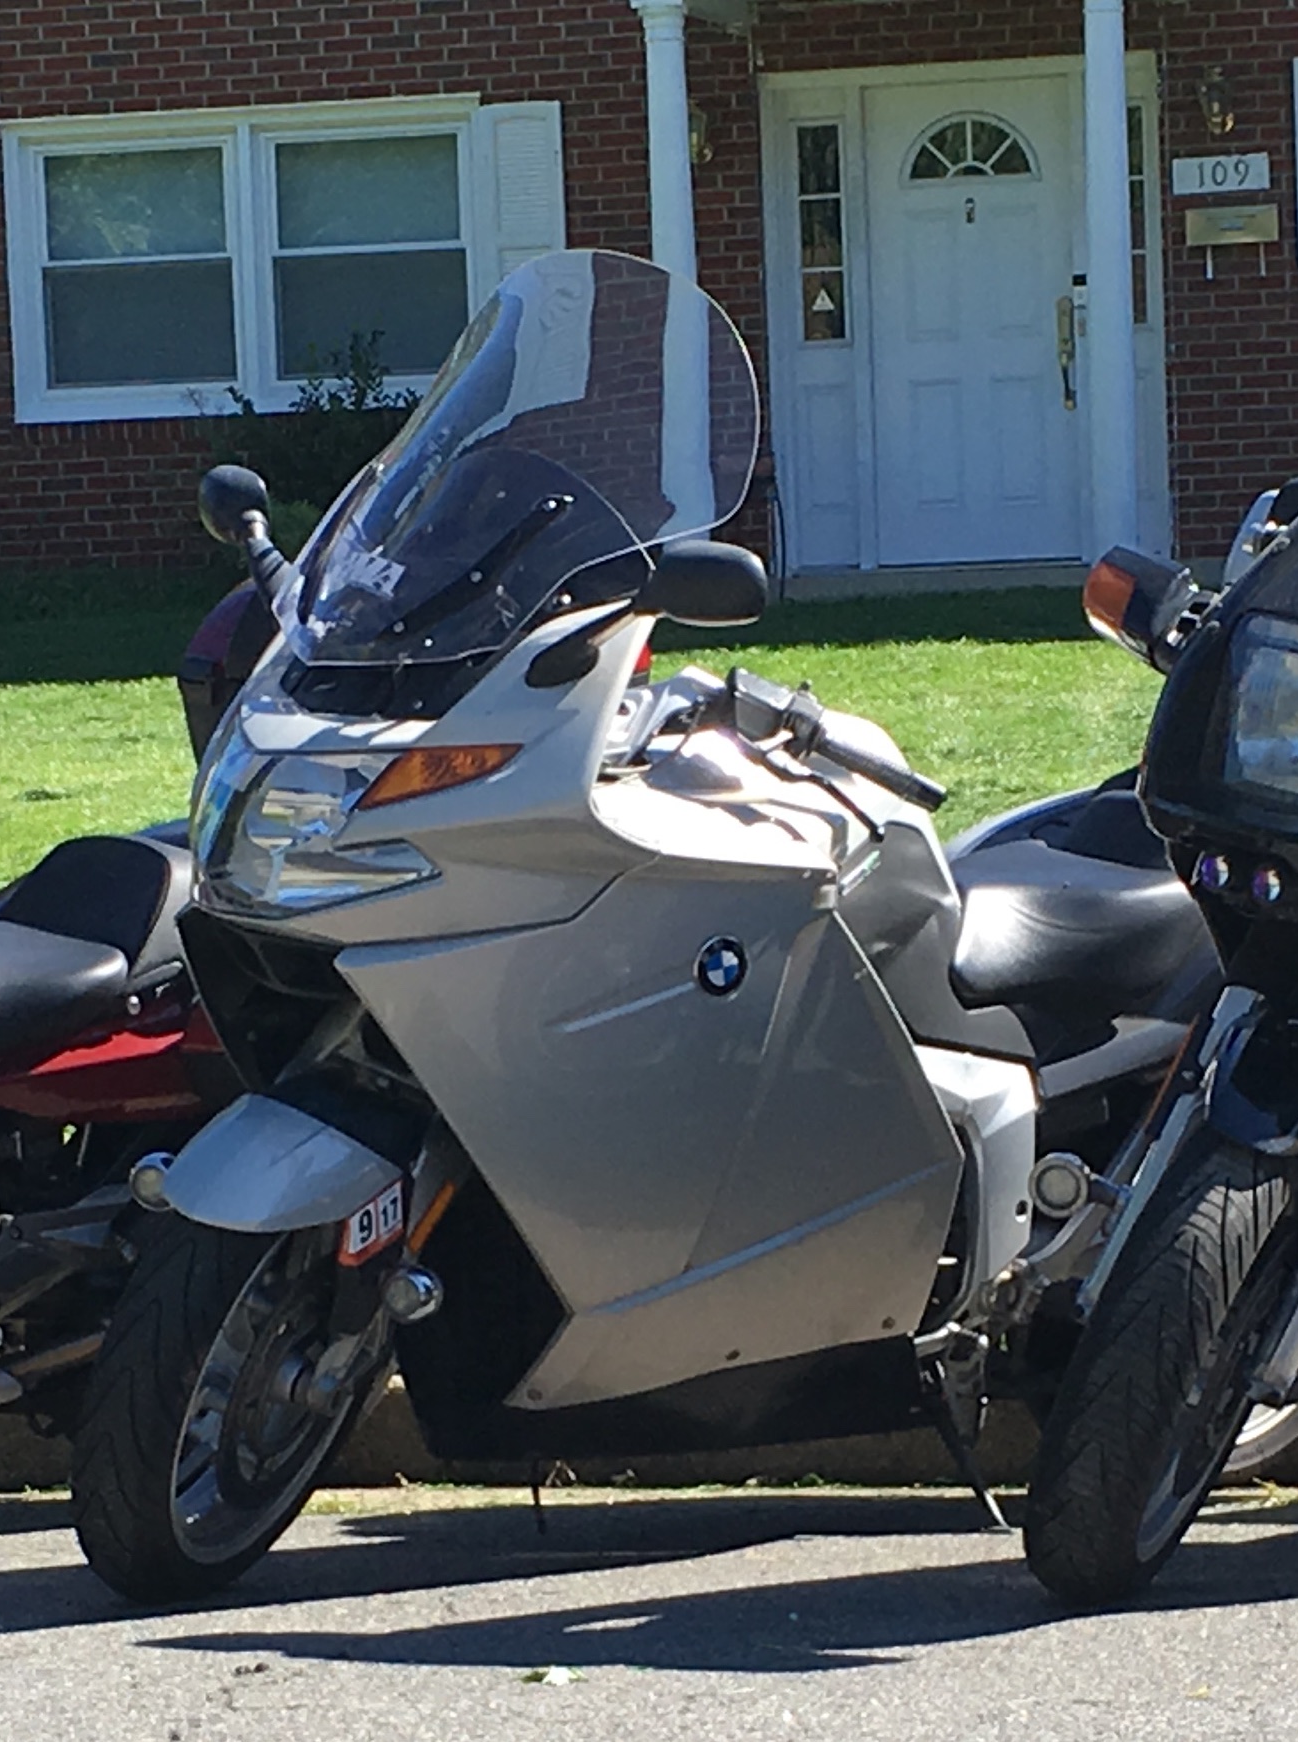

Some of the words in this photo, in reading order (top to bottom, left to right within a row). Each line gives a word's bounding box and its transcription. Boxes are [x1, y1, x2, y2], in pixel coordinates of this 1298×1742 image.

[1196, 157, 1251, 189] 109
[358, 1208, 373, 1244] 9
[381, 1196, 399, 1228] 17
